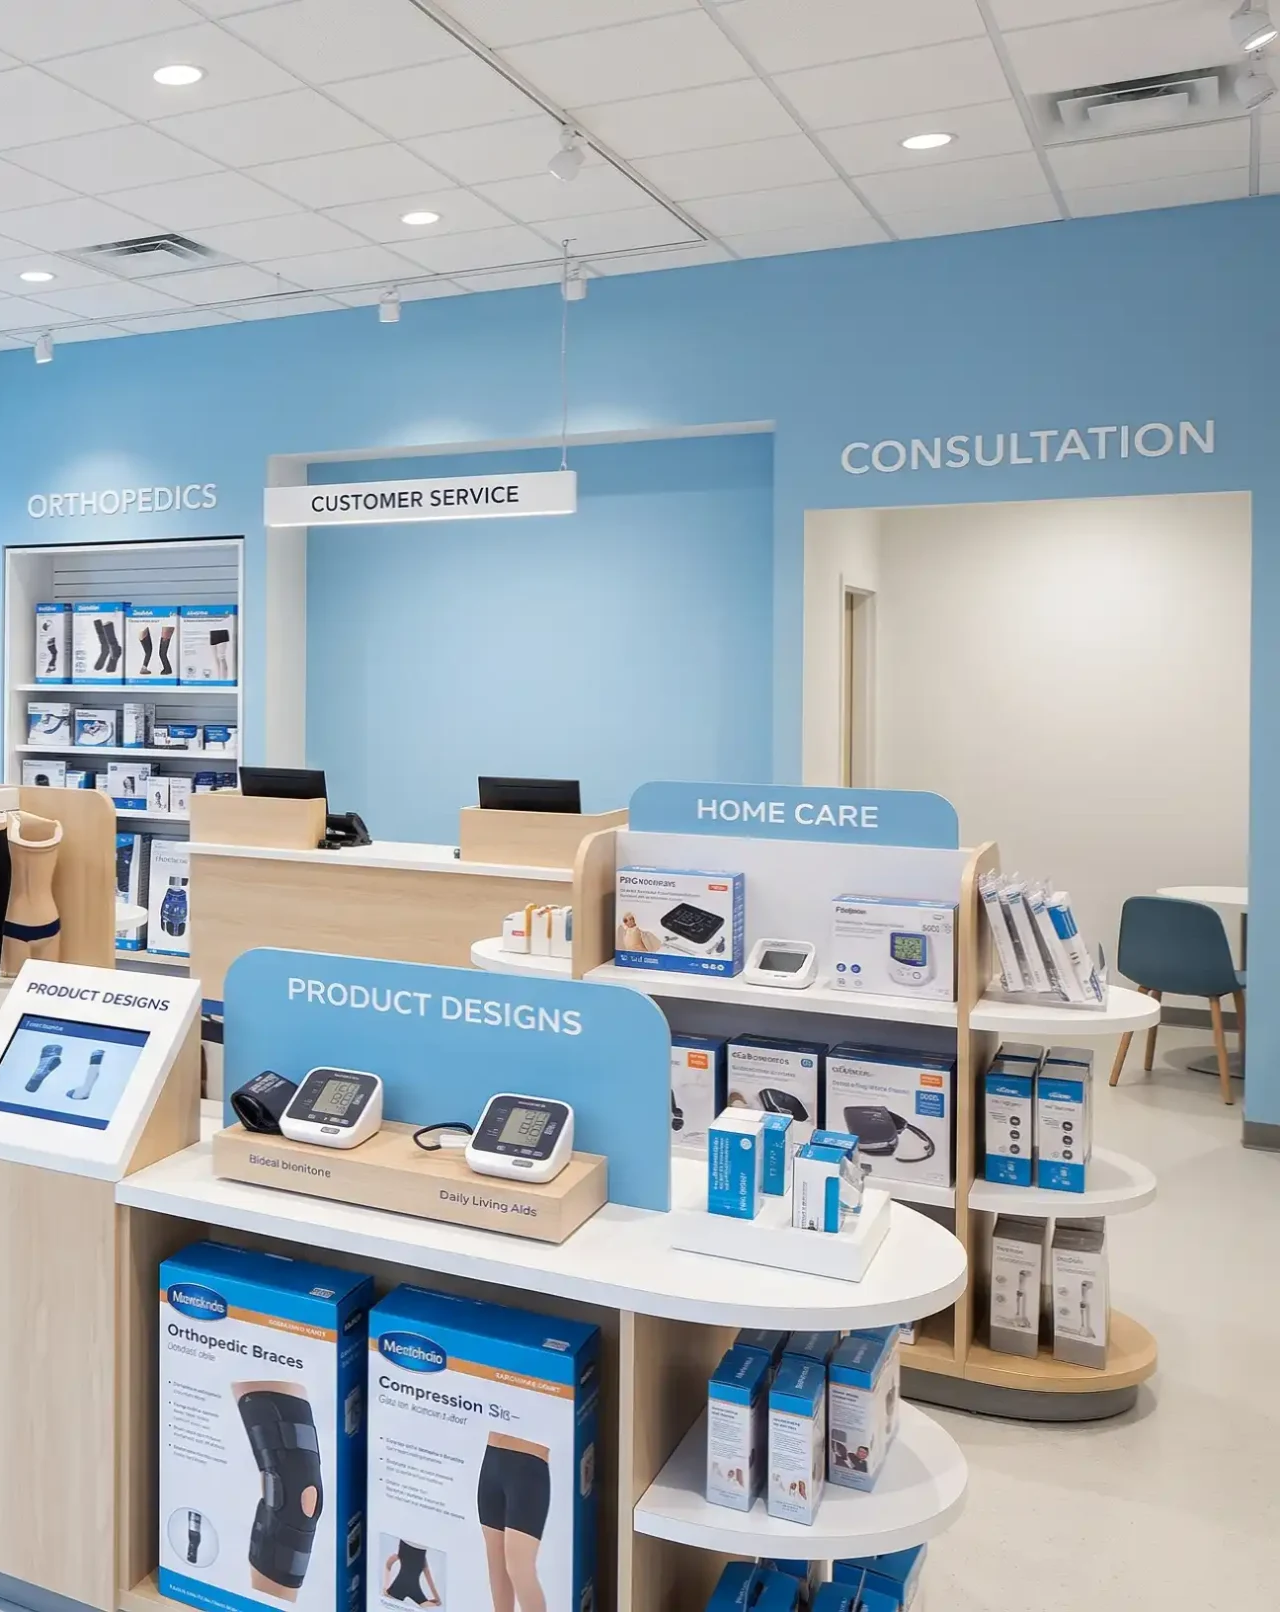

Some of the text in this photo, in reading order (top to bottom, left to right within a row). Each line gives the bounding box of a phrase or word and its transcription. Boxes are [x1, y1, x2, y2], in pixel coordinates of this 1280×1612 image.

[840, 420, 1215, 475] CONSULTATION
[27, 483, 217, 519] ORTHOPEDICS
[311, 485, 519, 512] CUSTOMER SERVICE
[697, 798, 879, 828] HOME CARE
[26, 982, 170, 1011] PRODUCT DESIGNS
[288, 977, 583, 1036] PRODUCT DESIGNS
[439, 1190, 469, 1206] Daily
[472, 1196, 508, 1213] Living
[167, 1323, 248, 1355] Orthopedic
[252, 1345, 304, 1370] Braces
[378, 1375, 483, 1414] Compression
